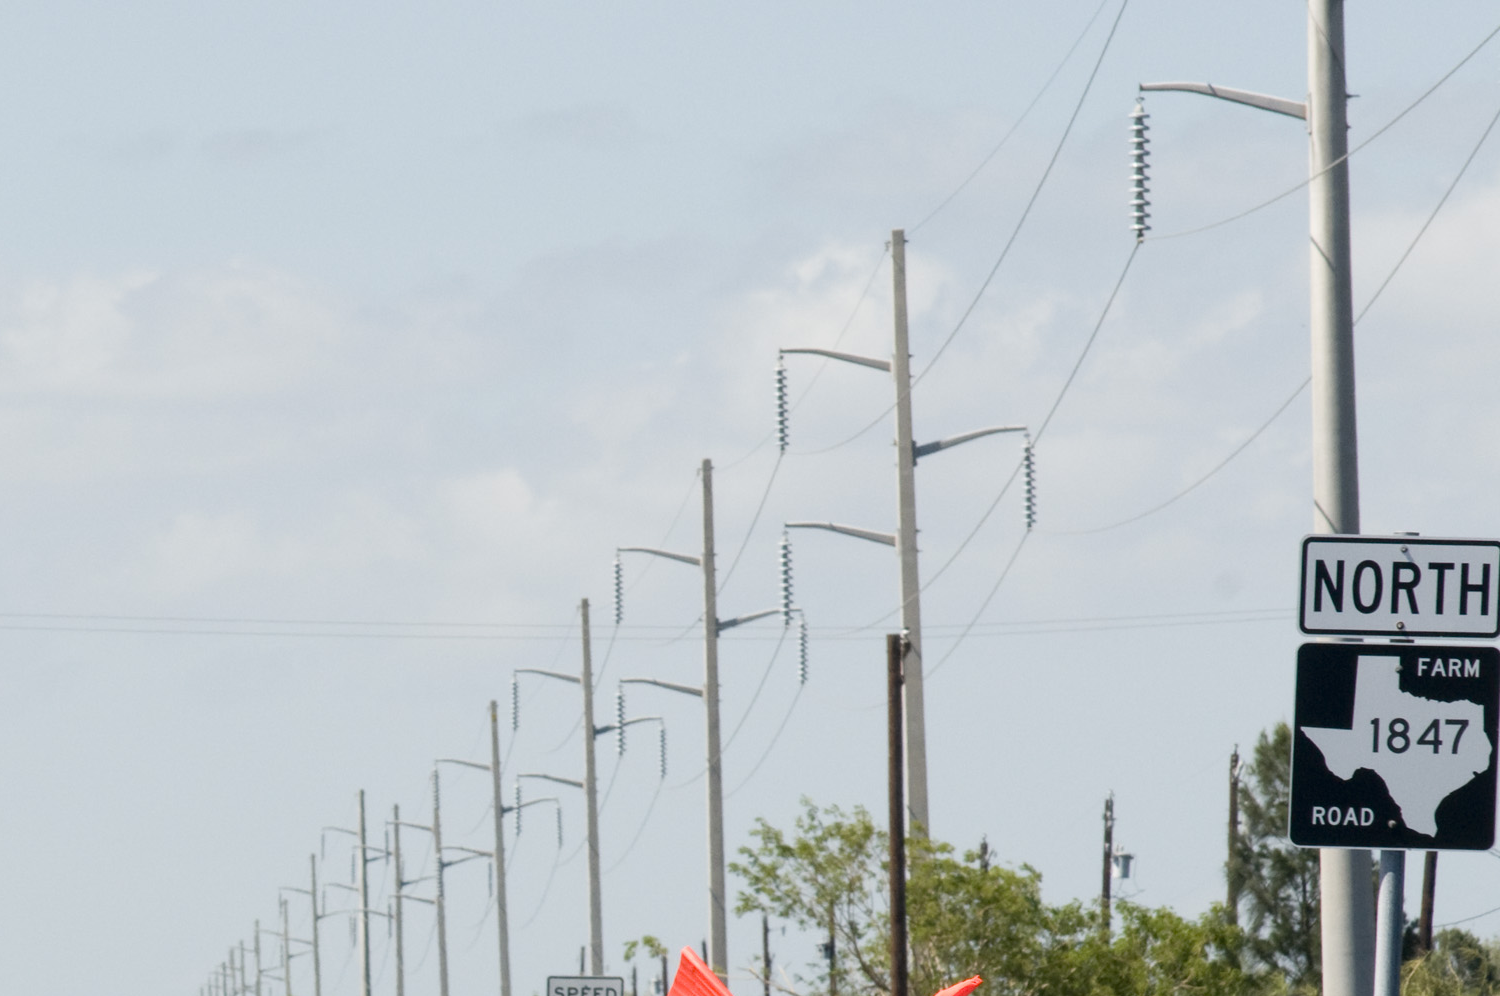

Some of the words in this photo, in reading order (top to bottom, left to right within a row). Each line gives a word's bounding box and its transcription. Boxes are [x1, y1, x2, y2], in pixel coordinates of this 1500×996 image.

[1313, 559, 1491, 616] NORTH
[1417, 657, 1481, 678] FARM
[1370, 717, 1470, 755] 1847
[1311, 806, 1375, 827] ROAD
